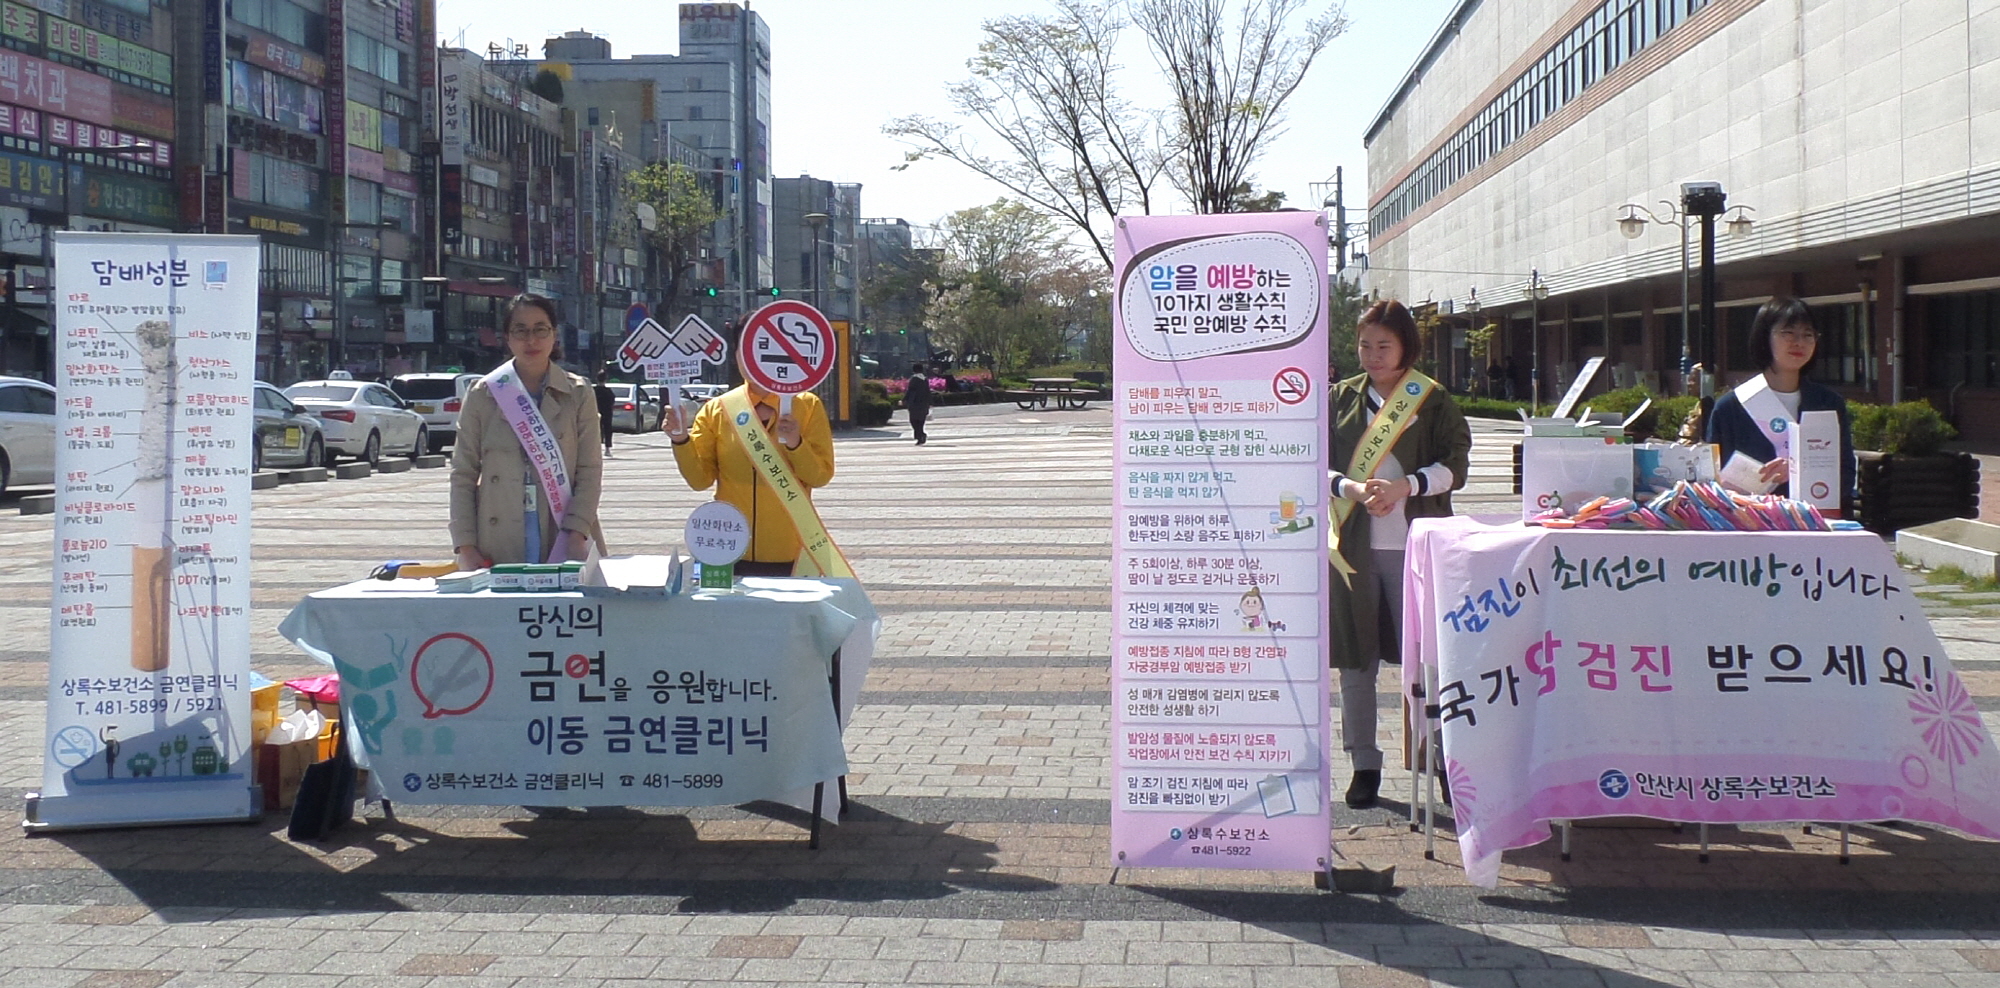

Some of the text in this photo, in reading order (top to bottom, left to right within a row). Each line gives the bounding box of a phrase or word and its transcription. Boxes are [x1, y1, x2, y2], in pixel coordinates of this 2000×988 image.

[51, 21, 98, 60] 리빙텔
[92, 260, 190, 286] 담배성분
[1150, 264, 1291, 291] 암을 예방하는
[69, 293, 89, 302] 타르
[1154, 292, 1286, 312] 10가지 생활수칙
[1154, 314, 1287, 334] 국민 암예방 수칙
[68, 328, 98, 338] 니코틴
[758, 336, 769, 350] 금
[66, 364, 120, 375] 일산화탄소
[776, 366, 788, 379] 연
[186, 393, 249, 406] 포름알데히드
[1129, 388, 1222, 400] 담배를 피우지 말고,
[64, 396, 93, 408] 카드뮴
[1129, 402, 1279, 414] 남이 피우는 담배 연기도 피하기
[517, 394, 546, 437] 흡연하면
[92, 426, 110, 437] 크롬
[188, 426, 211, 436] 벤젠
[1128, 430, 1268, 442] 채소와 과일을 충분하게 먹고,
[1358, 400, 1408, 473] 상록수보건소
[516, 420, 547, 465] 금연하면
[1128, 445, 1311, 457] 다채로운 식단으로 균형 잡힌 식사하기
[185, 454, 206, 466] 페놀
[746, 429, 798, 502] 상록수보건소
[67, 472, 89, 482] 부탄
[1128, 471, 1236, 484] 음식을 짜지 않게 먹고,
[1128, 487, 1223, 499] 탄 음식을 먹지 않기
[64, 502, 136, 514] 비닐클로라이드
[182, 514, 238, 525] 나프틸아민
[692, 519, 744, 532] 일산화탄소
[1128, 514, 1230, 527] 암예방을 위하여 하루
[1128, 530, 1265, 542] 한두잔의 소량 음주도 피하기
[62, 539, 107, 550] 폴로늄210
[695, 536, 736, 550] 무료측정
[1128, 558, 1262, 570] 주 5회이상, 하루 30분 이상,
[63, 572, 96, 581] 우레탄
[1128, 573, 1280, 586] 땀이 날 정도로 걷거나 운동하기
[1443, 546, 1905, 634] 검진이 최선의 예방입니다.
[61, 602, 94, 616] 메탄올
[1128, 602, 1220, 615] 자신의 체격에 맞는
[517, 604, 603, 638] 당신의
[1128, 617, 1219, 630] 건강 체중 유지하기
[1127, 646, 1287, 659] 예방접종 지침에 따라 B형 간염과
[1127, 661, 1251, 674] 자궁경부암 예방접종 받기
[1707, 642, 1935, 694] 받으세요!
[520, 650, 778, 704] 금연을 응원합니다.
[61, 674, 238, 696] 상록수보건소 금연클리닉
[1127, 689, 1280, 702] 성 매개 감염병에 걸리지 않도록
[76, 697, 223, 716] T. 481-5899 5921
[1127, 704, 1220, 717] 안전한 성생활 하기
[527, 714, 769, 755] 이동 금연클리닉
[1127, 732, 1276, 746] 발암성 물질에 노출되지 않도록
[1127, 749, 1291, 762] 작업장에서 안전 보건 수칙 지키기
[425, 772, 724, 790] 상록수보건소 금연클리닉 481-5899
[1127, 777, 1248, 790] 암 조기 검진 지침에 따라
[1635, 772, 1836, 800] 안산시 상록수보건소
[1127, 792, 1230, 806] 검진을 빠짐없이 받기
[1187, 828, 1270, 840] 상록수보건소
